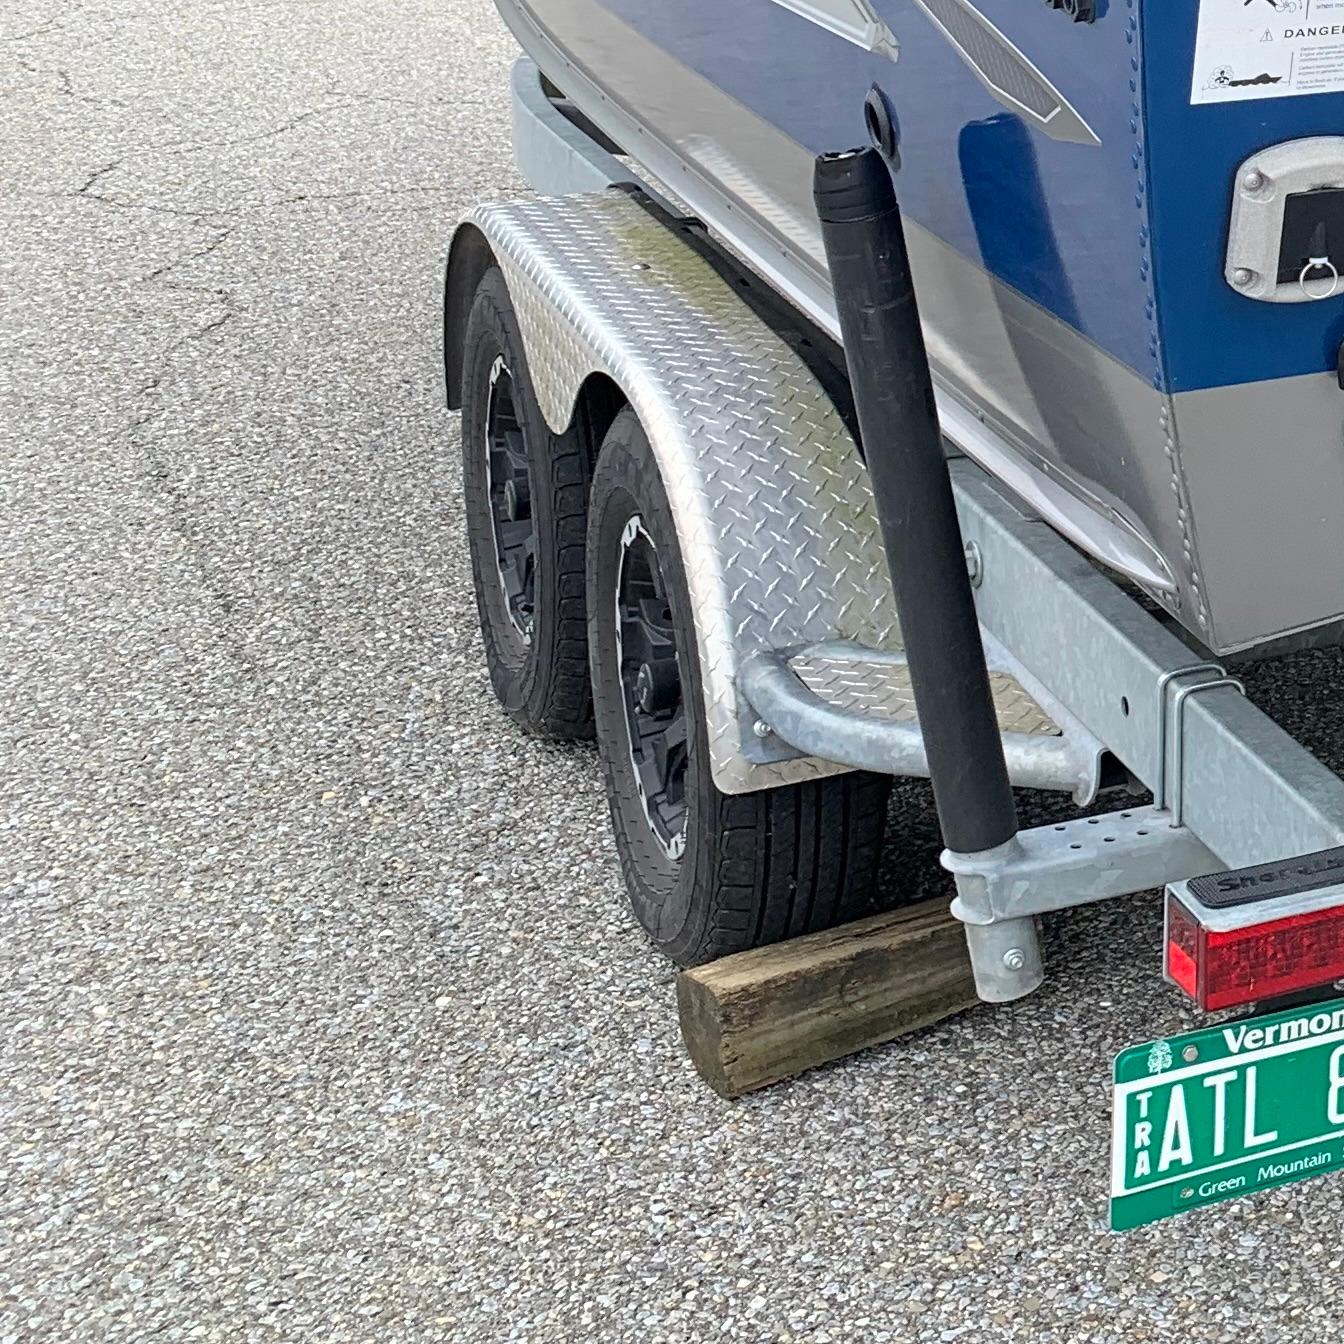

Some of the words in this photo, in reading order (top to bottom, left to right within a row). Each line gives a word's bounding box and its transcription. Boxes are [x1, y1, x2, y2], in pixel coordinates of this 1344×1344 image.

[1157, 1065, 1278, 1173] ATL
[1198, 1173, 1246, 1198] Green
[1256, 1150, 1332, 1182] Mountain
